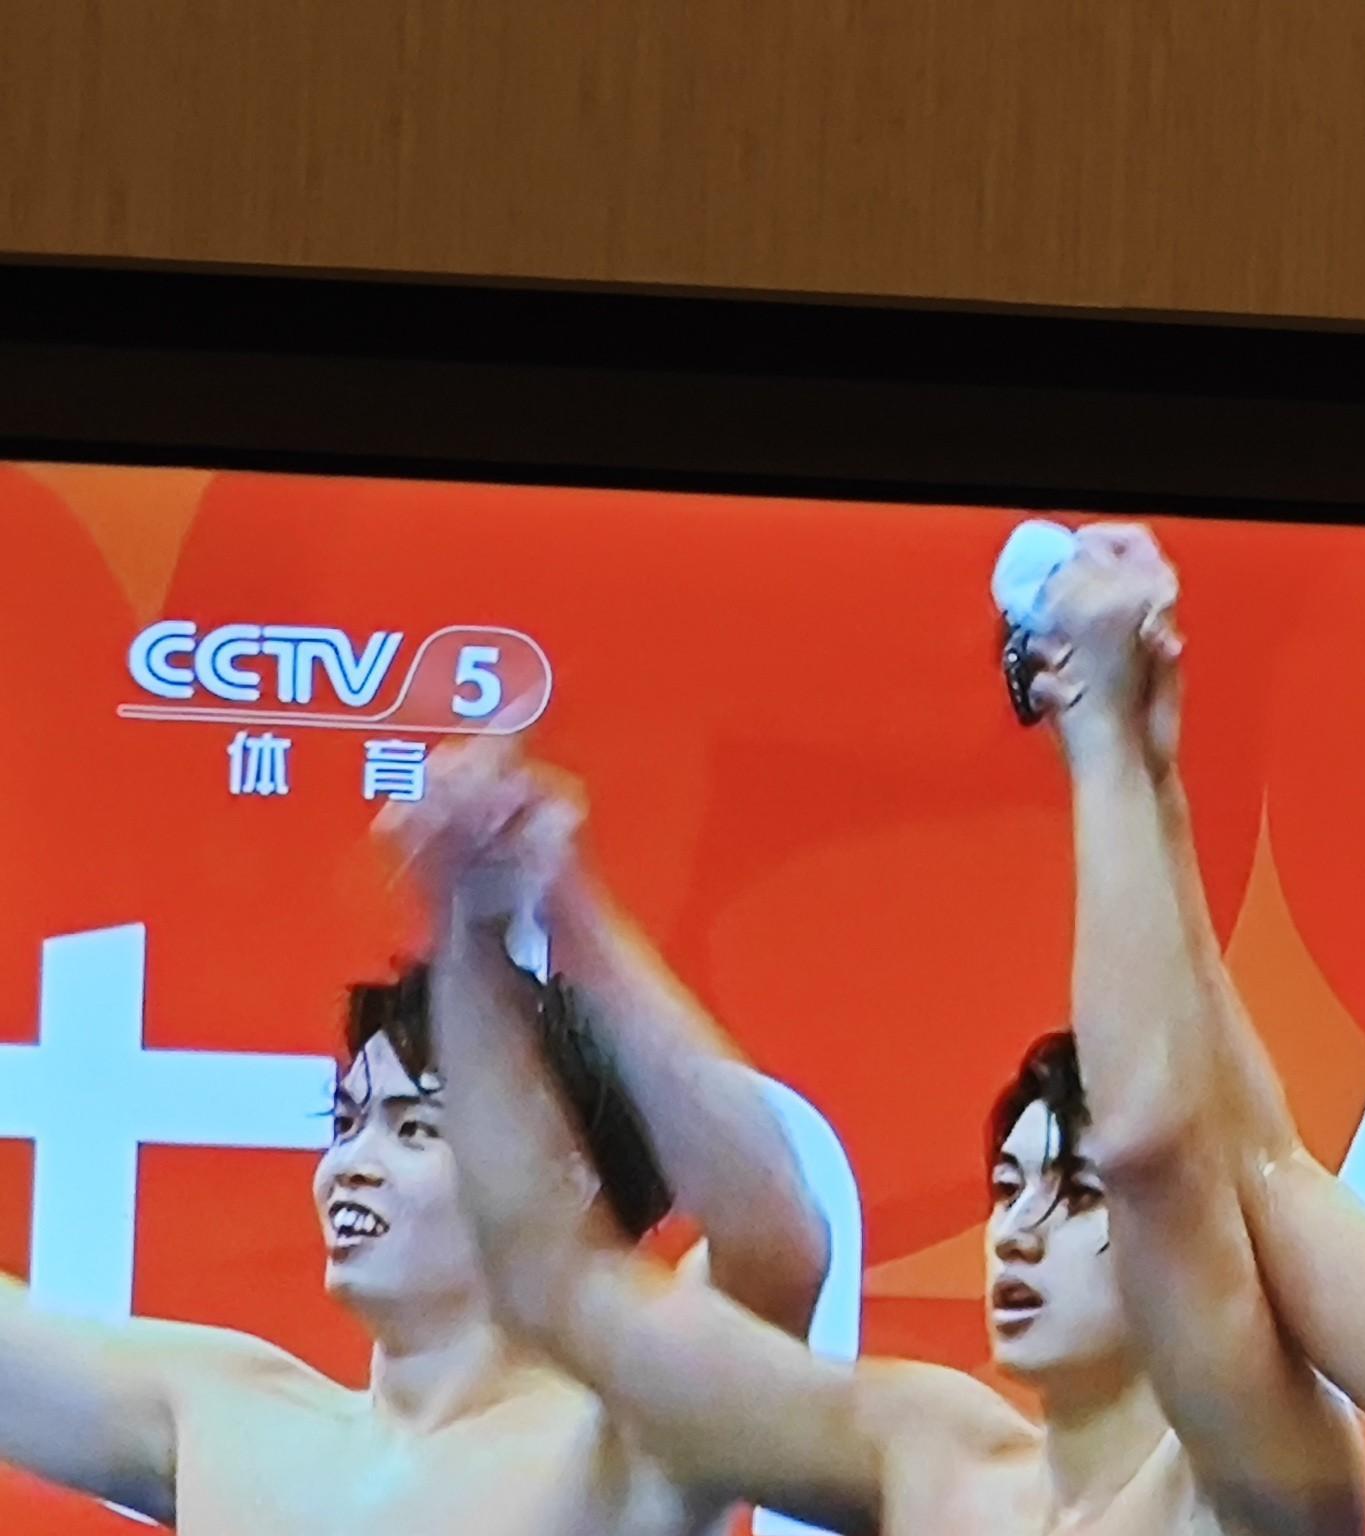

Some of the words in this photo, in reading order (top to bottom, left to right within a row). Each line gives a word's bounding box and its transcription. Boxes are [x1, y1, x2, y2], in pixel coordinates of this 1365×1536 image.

[128, 620, 404, 708] CCTV
[451, 646, 502, 718] 5
[227, 731, 427, 801] 体育
